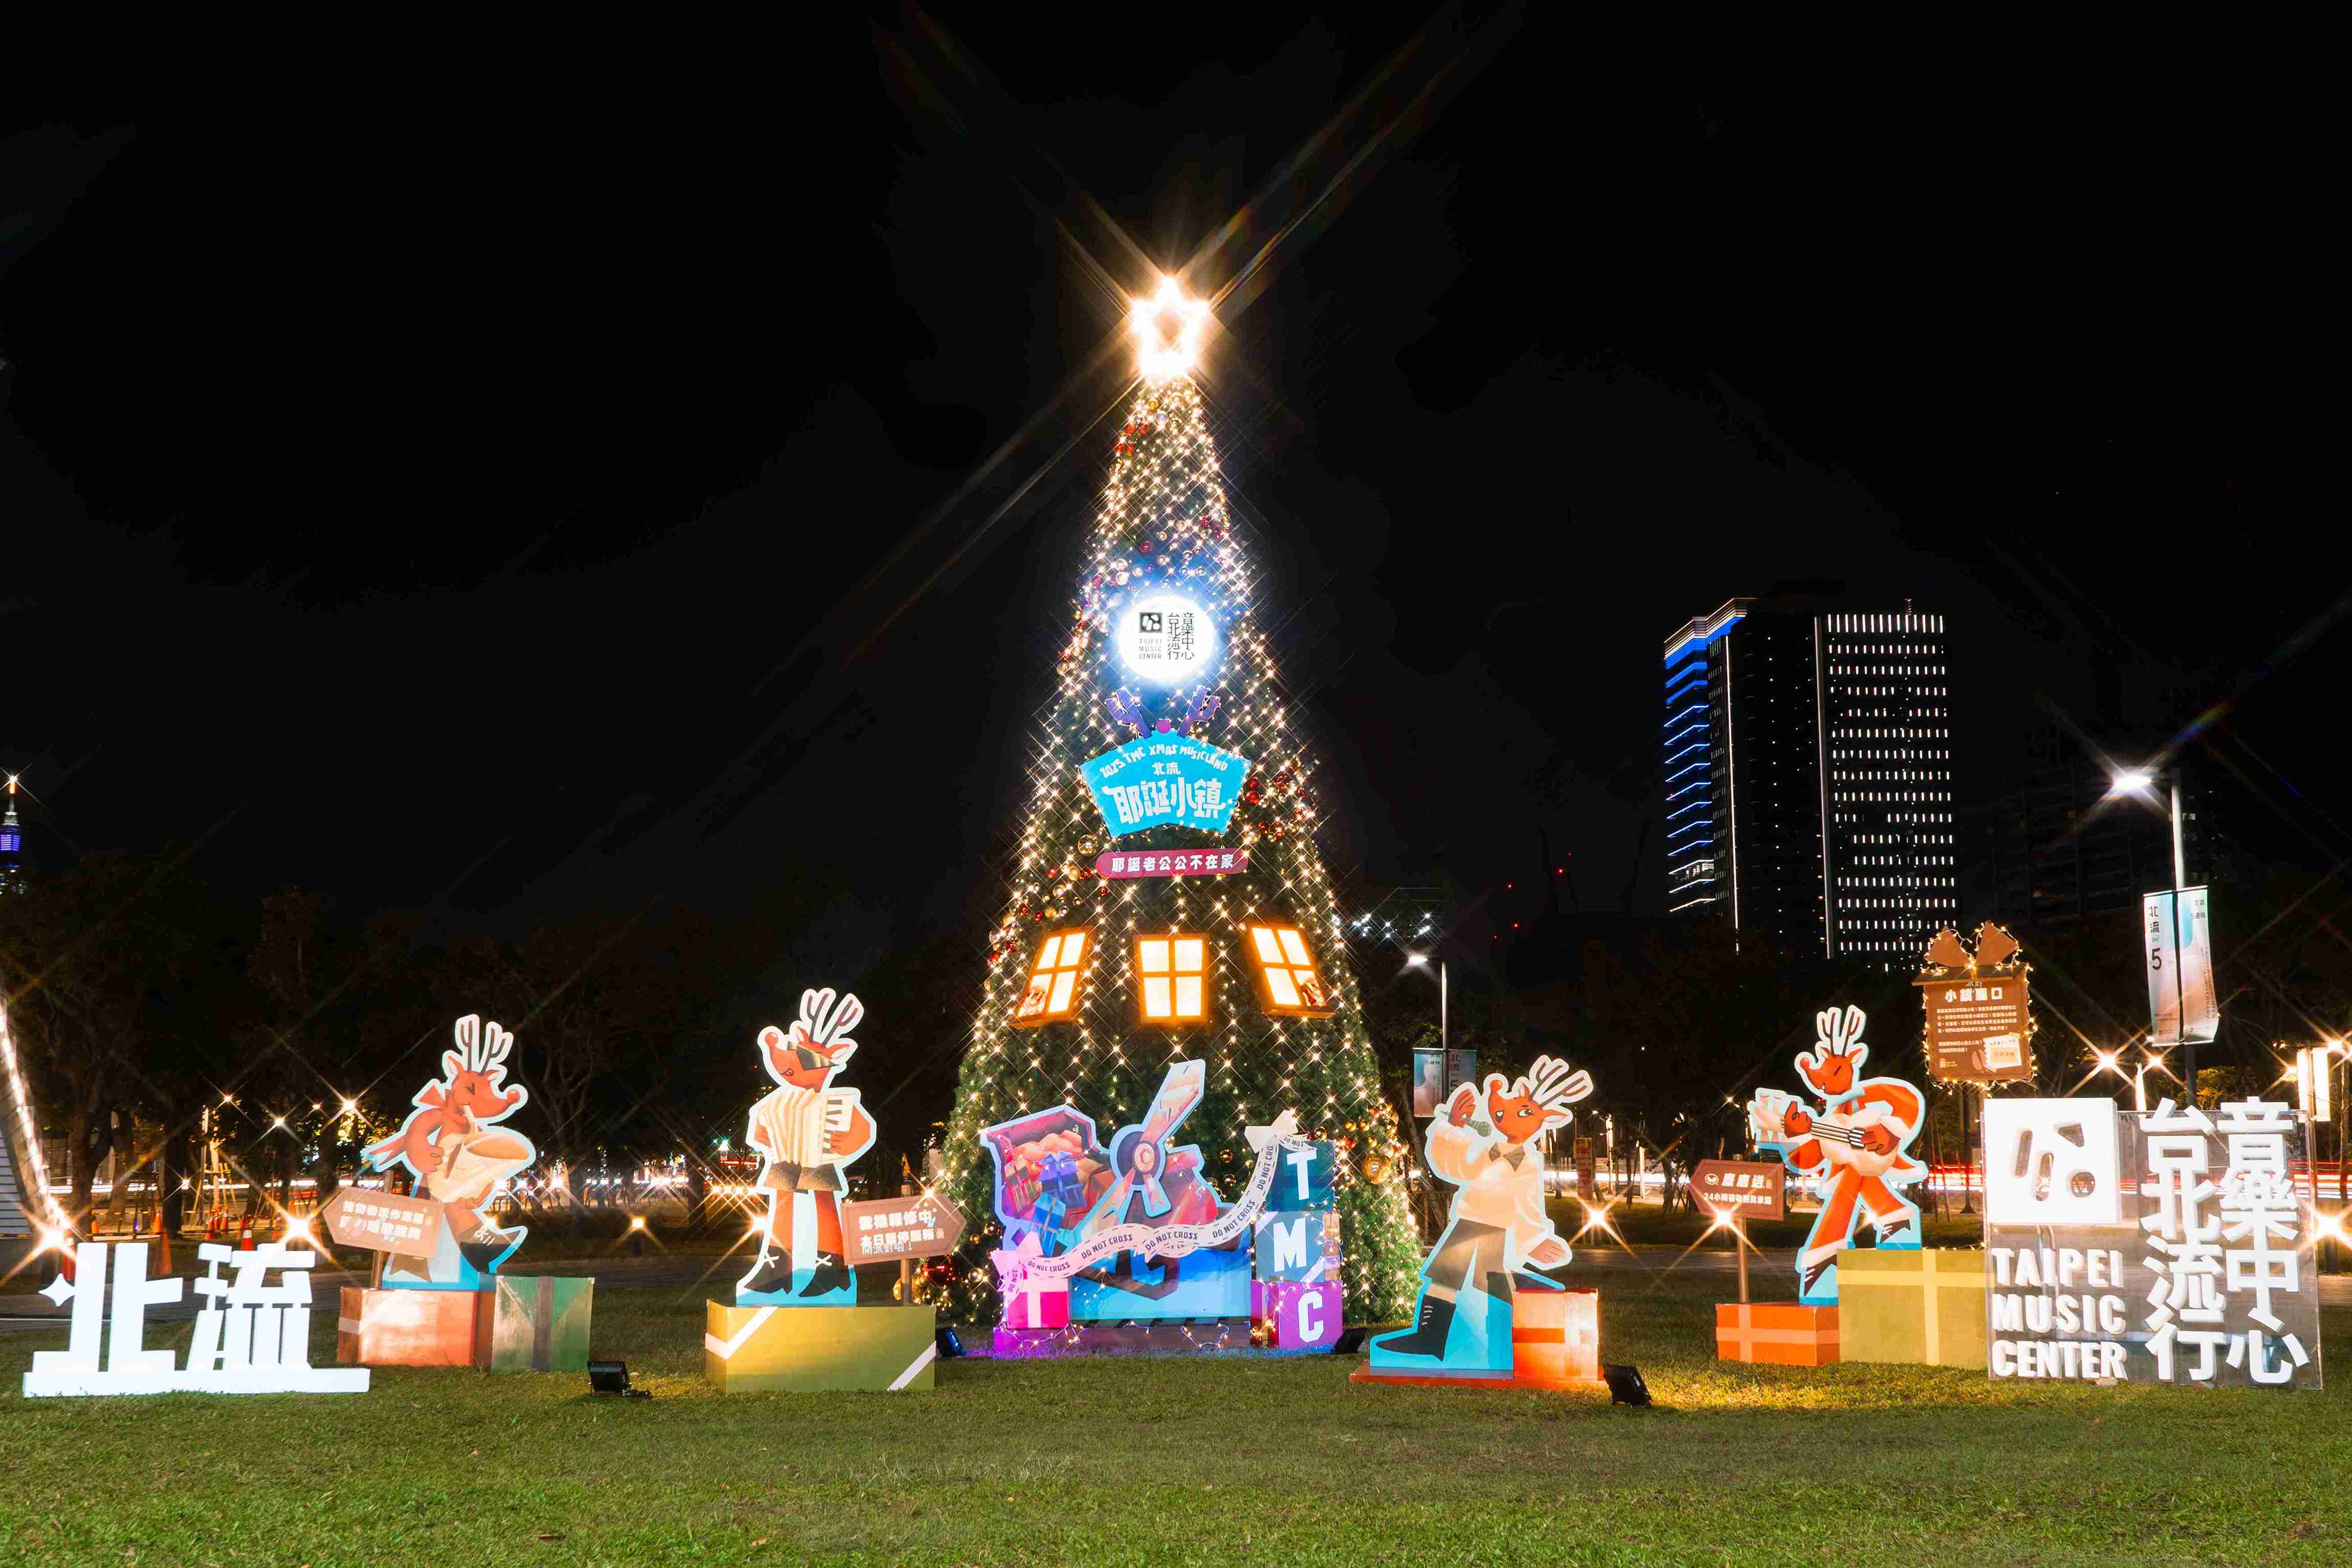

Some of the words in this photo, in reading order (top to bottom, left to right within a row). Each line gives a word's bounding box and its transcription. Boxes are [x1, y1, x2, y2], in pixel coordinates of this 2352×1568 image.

[1167, 612, 1180, 660] 台北流行
[1181, 612, 1195, 660] 音樂中心
[1100, 758, 1126, 779] 2025
[1123, 746, 1146, 763] TMC
[1149, 744, 1177, 756] XMAS
[1179, 745, 1228, 771] MUSICLAND
[1152, 761, 1182, 776] 北流
[1102, 777, 1226, 824] 耶誕小鎮
[1111, 853, 1235, 873] 耶誕老公公不在家
[2151, 947, 2162, 970] 5
[1261, 1162, 1271, 1178] NOT
[1265, 1145, 1274, 1160] CRO
[1257, 1179, 1266, 1190] DO
[1212, 1228, 1223, 1238] DO
[1223, 1220, 1238, 1234] NOT
[1237, 1200, 1256, 1223] CROSS
[1081, 1250, 1091, 1260] DO
[1091, 1241, 1107, 1252] NOT
[1109, 1234, 1133, 1245] CROSS
[1145, 1241, 1156, 1251] DO
[1156, 1232, 1172, 1244] NOT
[1174, 1231, 1198, 1240] CROSS
[2139, 1097, 2227, 1381] 台北流行
[2217, 1096, 2311, 1384] 音樂中心
[1049, 1261, 1070, 1272] CROSS
[1991, 1248, 2125, 1288] TAIPEI
[1007, 1284, 1015, 1292] DO
[32, 1243, 316, 1373] 北流
[1991, 1294, 2127, 1334] MUSIC
[1992, 1340, 2128, 1379] CENTER
